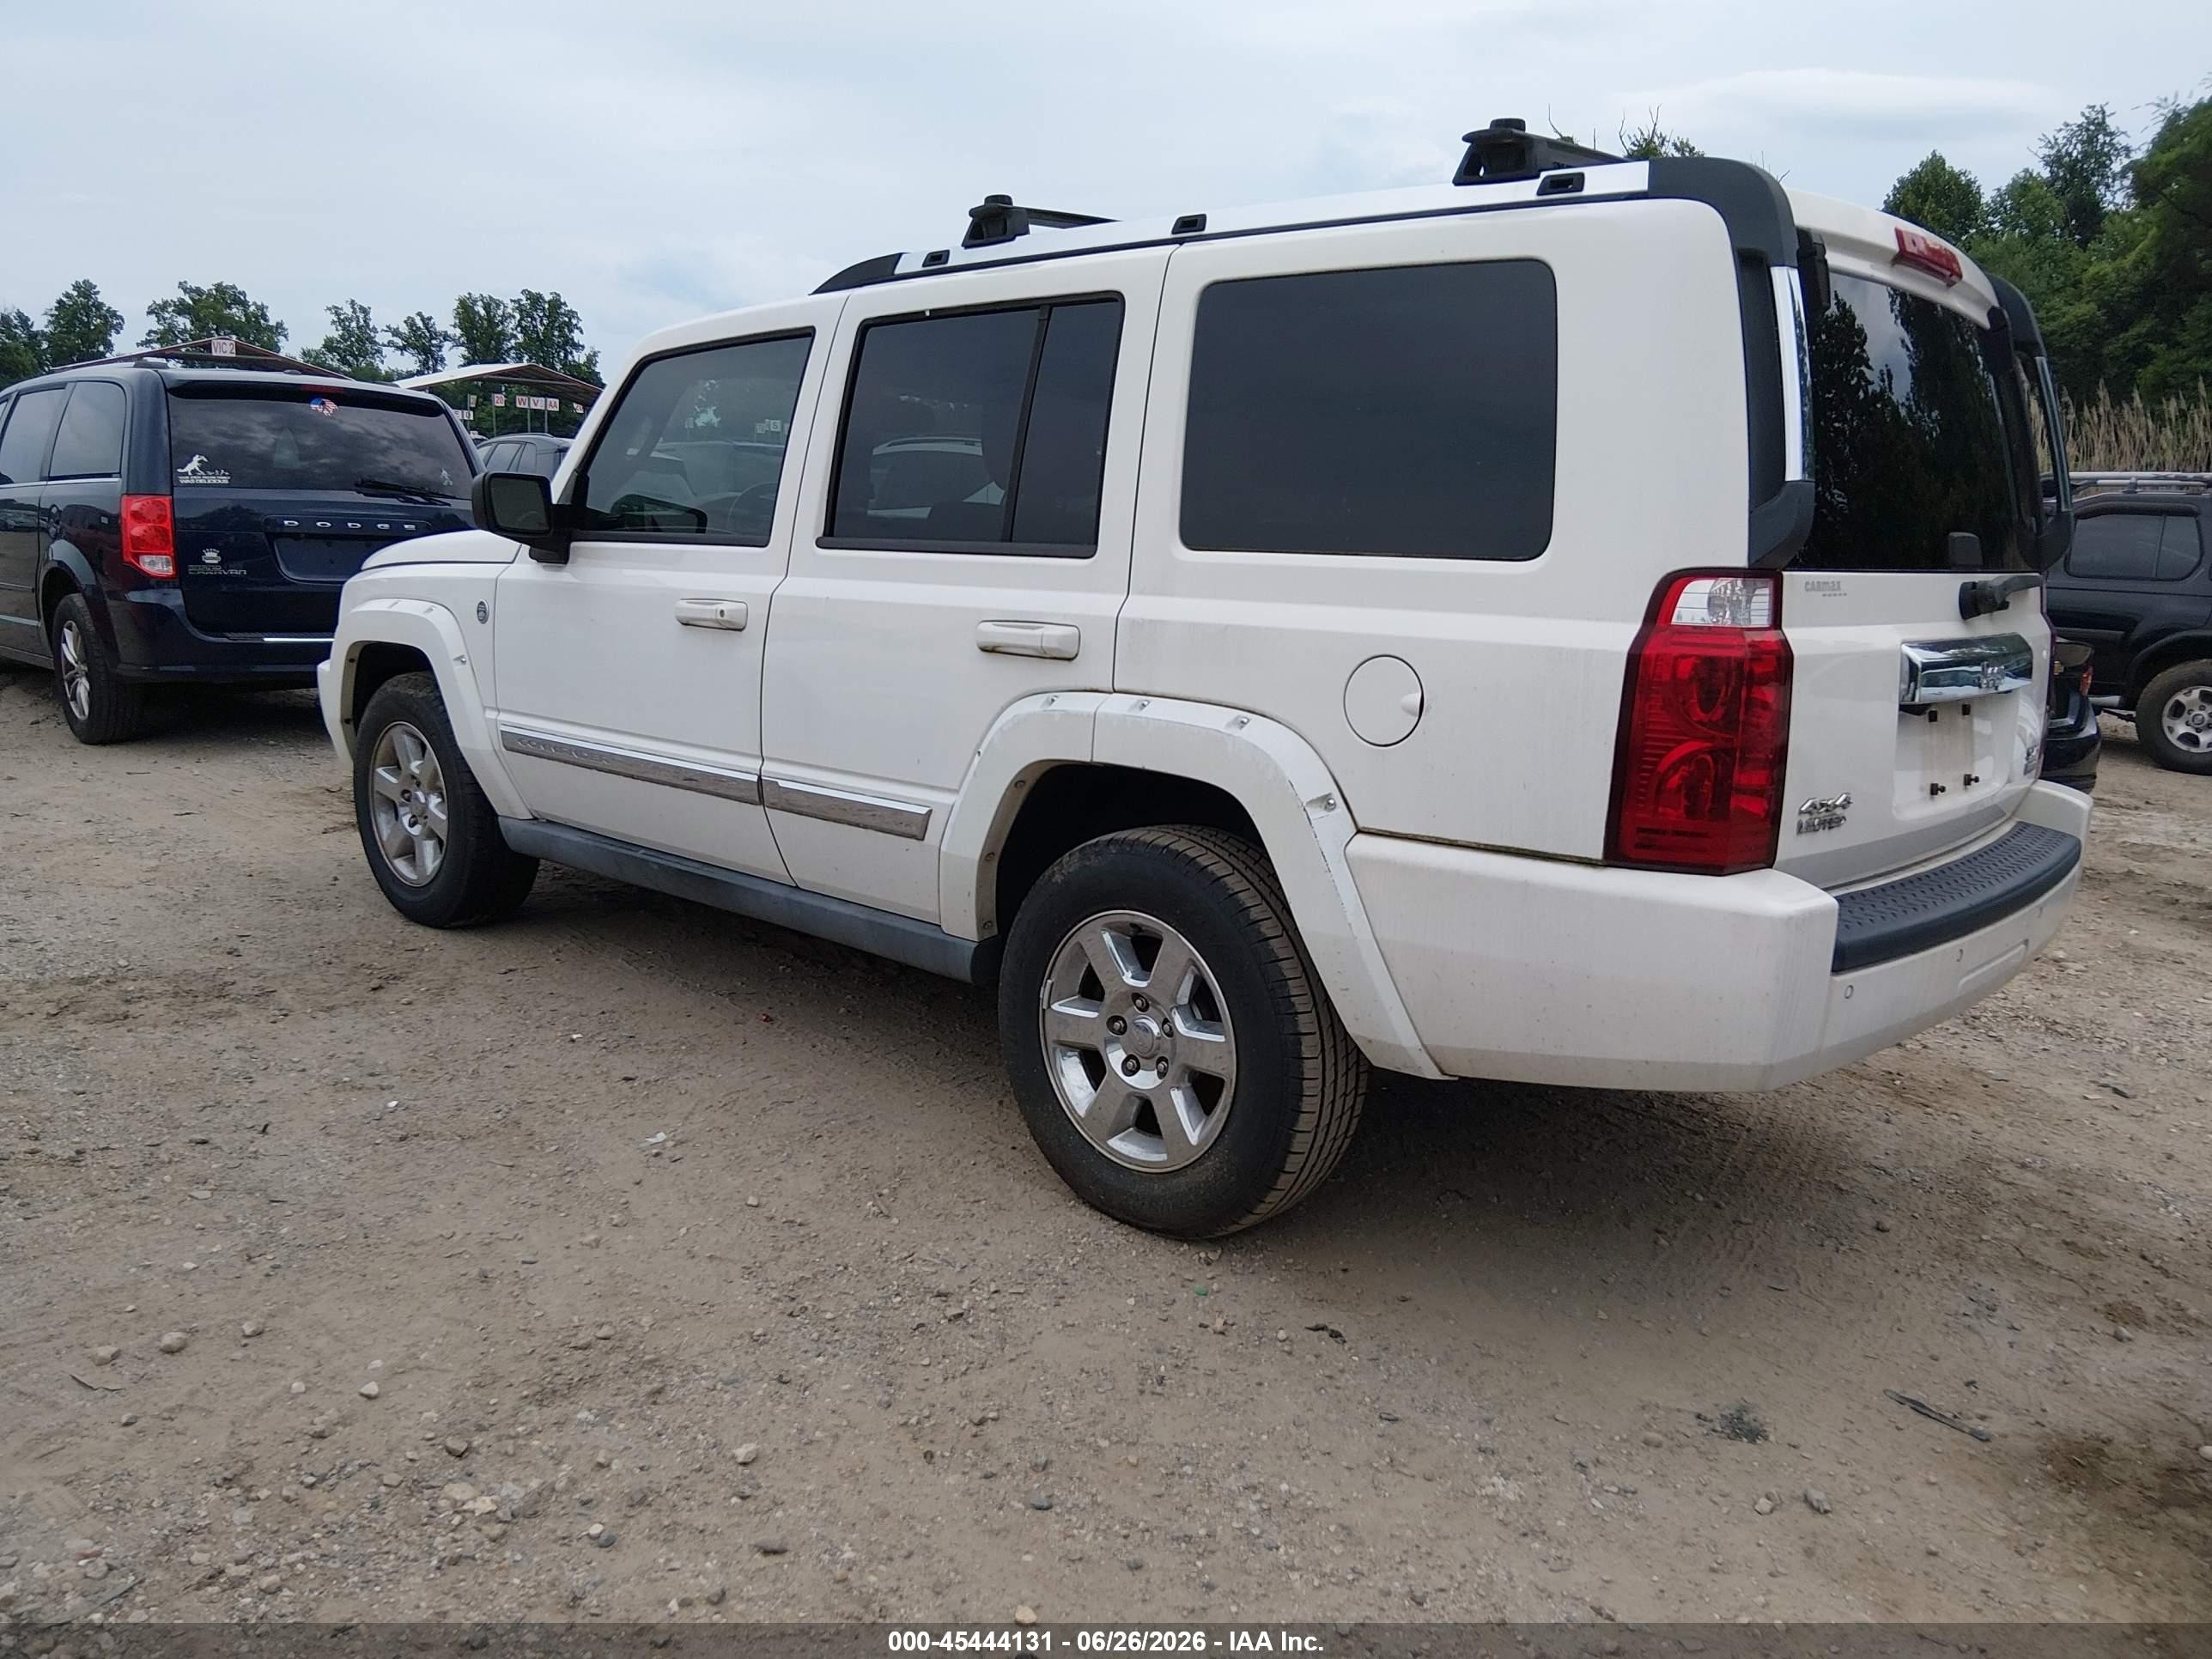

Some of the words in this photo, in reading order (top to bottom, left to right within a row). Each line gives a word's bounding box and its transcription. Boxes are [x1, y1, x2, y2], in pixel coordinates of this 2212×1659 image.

[213, 342, 228, 354] VIC
[229, 343, 234, 354] 2
[518, 398, 527, 406] W
[549, 400, 558, 409] AA
[283, 520, 416, 531] DODGE
